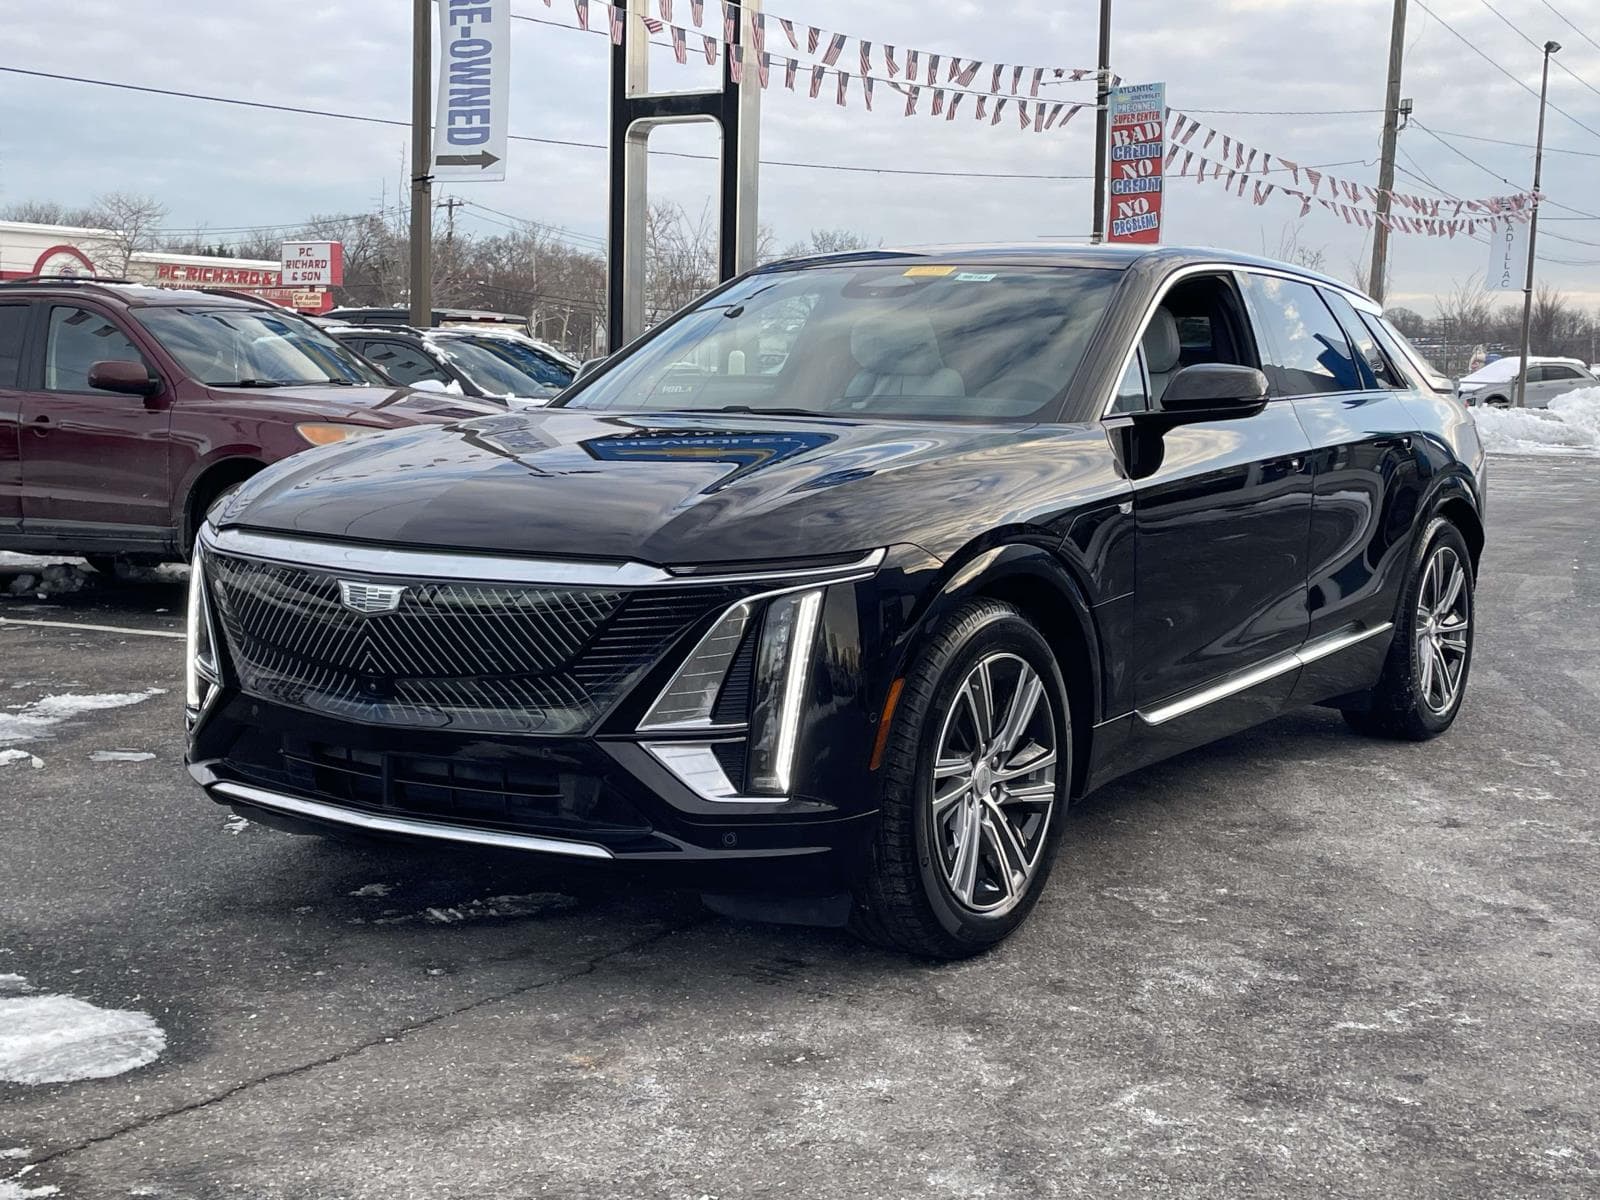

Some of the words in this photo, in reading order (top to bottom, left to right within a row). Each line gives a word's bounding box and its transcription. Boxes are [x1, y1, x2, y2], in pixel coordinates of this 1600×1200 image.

[1119, 84, 1153, 94] ATLANTIC
[1113, 113, 1135, 124] SUPER
[1136, 111, 1160, 122] CENTER
[1113, 122, 1161, 147] BAD
[1112, 143, 1161, 160] CREDIT
[1121, 160, 1153, 180] NO
[1112, 177, 1161, 194] CREDIT
[1117, 197, 1149, 219] NO
[1114, 213, 1157, 235] PROBLEM!
[286, 259, 328, 269] RICHARD
[185, 266, 260, 285] RICHARD
[262, 271, 271, 286] &
[292, 271, 298, 281] &
[301, 271, 321, 281] SON
